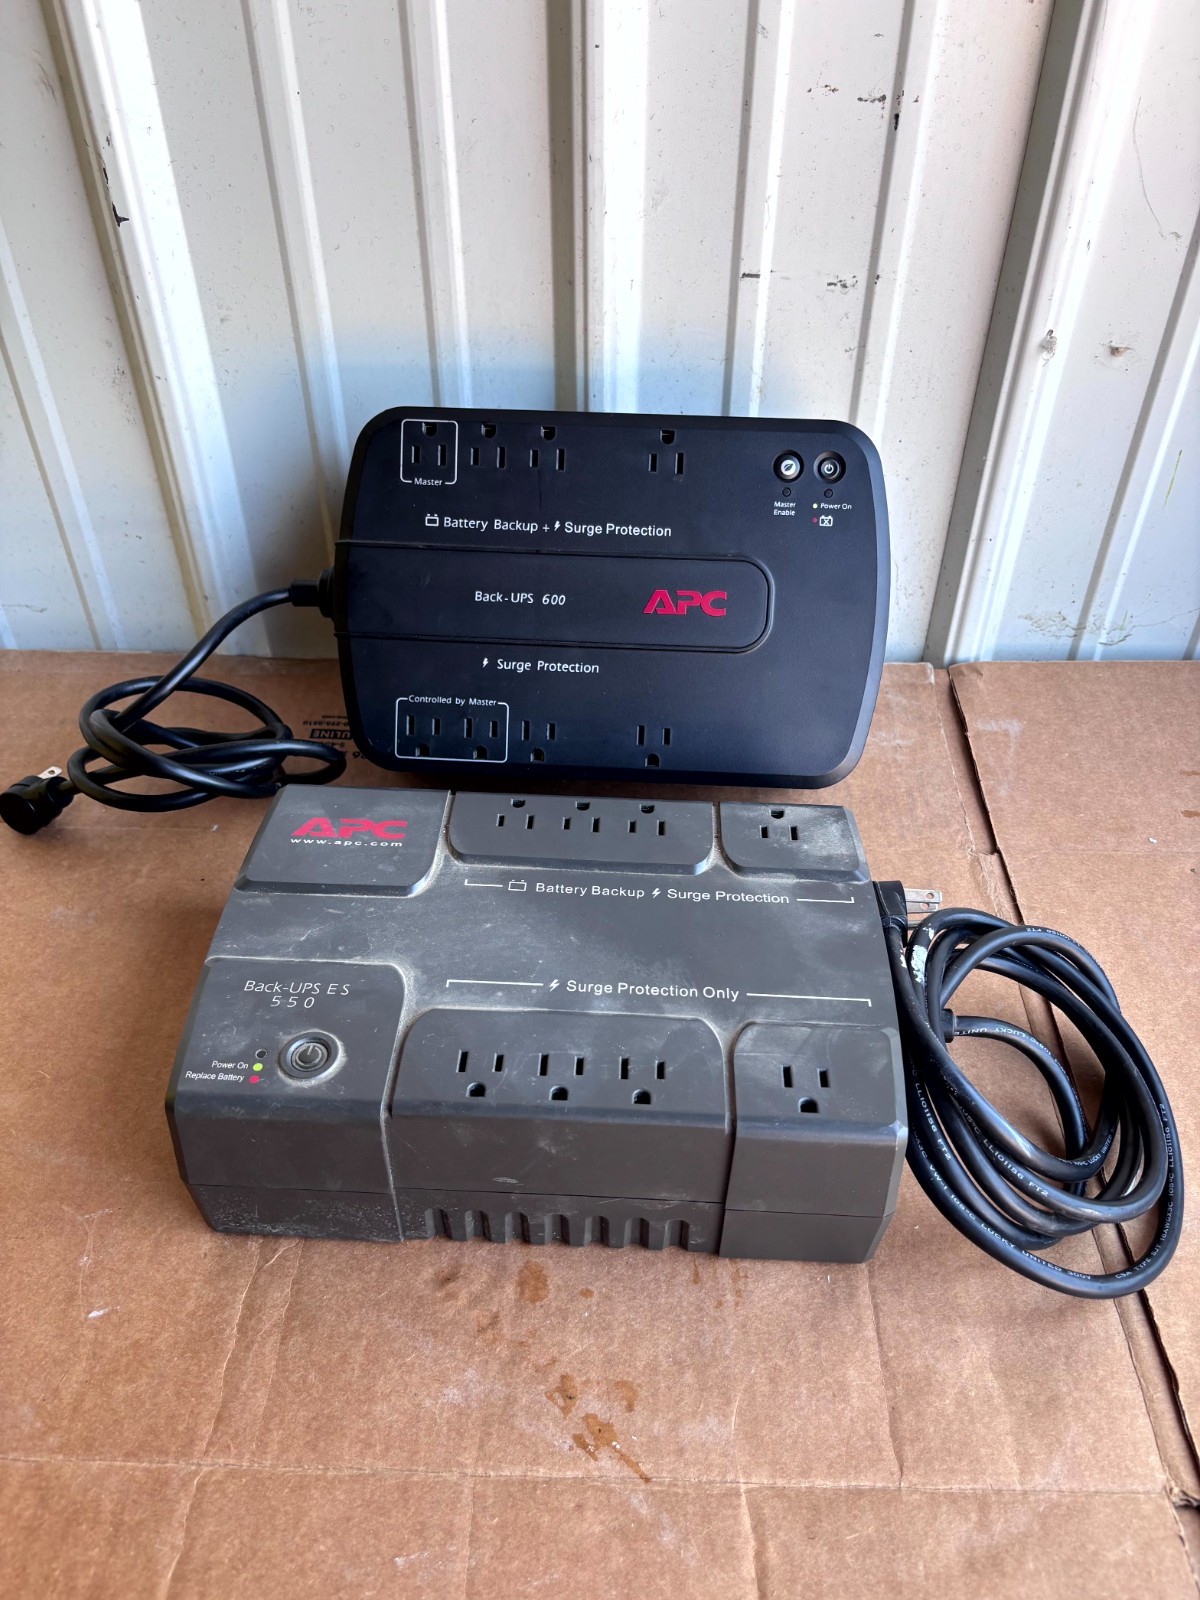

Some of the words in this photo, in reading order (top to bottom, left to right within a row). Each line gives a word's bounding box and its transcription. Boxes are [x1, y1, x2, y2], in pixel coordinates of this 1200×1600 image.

[414, 477, 443, 486] Master
[820, 502, 841, 510] Power
[443, 516, 489, 532] Battery
[493, 519, 539, 534] Backup
[564, 521, 603, 536] Surge
[605, 523, 672, 537] Protection
[474, 591, 534, 604] Back-UPS
[541, 594, 566, 606] 600
[642, 589, 728, 617] APC
[496, 659, 532, 673] Surge
[537, 660, 600, 674] Protection
[408, 694, 452, 704] Controlled
[455, 697, 466, 707] by
[468, 698, 497, 706] Master
[313, 730, 350, 738] ULINE
[290, 817, 408, 840] APC
[290, 838, 403, 847] www.apc.com
[535, 882, 588, 897] Battery
[591, 885, 645, 900] Backup
[666, 887, 711, 902] Surge
[715, 890, 790, 904] Protection
[243, 980, 323, 995] Back-UPS
[566, 980, 613, 996] Surge
[617, 982, 699, 998] Protection
[702, 986, 740, 1002] Only
[954, 1027, 988, 1036] UNITE
[993, 1027, 1026, 1038] LUCKY
[211, 1060, 236, 1069] Power
[237, 1061, 249, 1070] On
[185, 1071, 217, 1080] Replace
[217, 1073, 245, 1083] Battery
[915, 1082, 938, 1133] LL101156
[937, 1138, 951, 1161] FT2
[983, 1138, 1025, 1180] LL101156
[1028, 1181, 1049, 1197] FT2
[981, 1222, 1016, 1248] LUCKY
[1021, 1250, 1062, 1272] UNITED
[1114, 1271, 1133, 1279] CSA
[1134, 1257, 1152, 1271] TYPE
